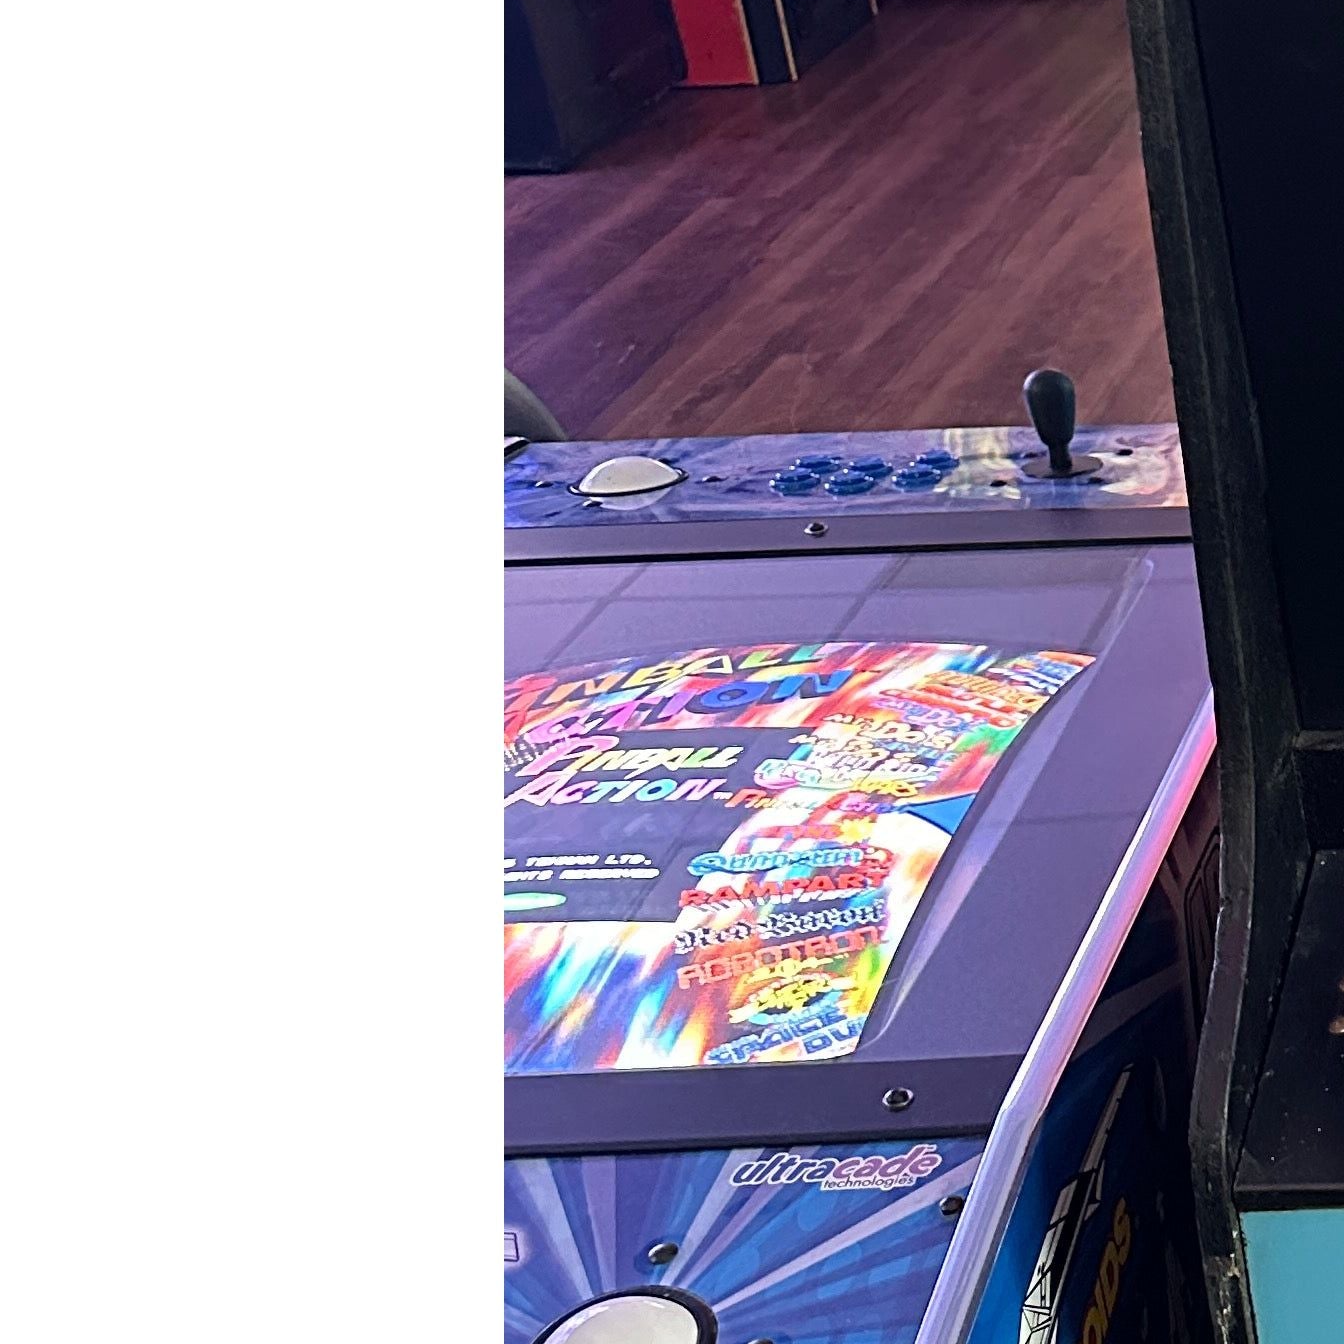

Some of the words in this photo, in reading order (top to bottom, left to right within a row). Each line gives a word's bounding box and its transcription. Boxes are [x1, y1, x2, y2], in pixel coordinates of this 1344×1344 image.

[678, 872, 890, 907] RAMPART
[731, 1144, 942, 1186] ultracade
[822, 1173, 916, 1191] technologies
